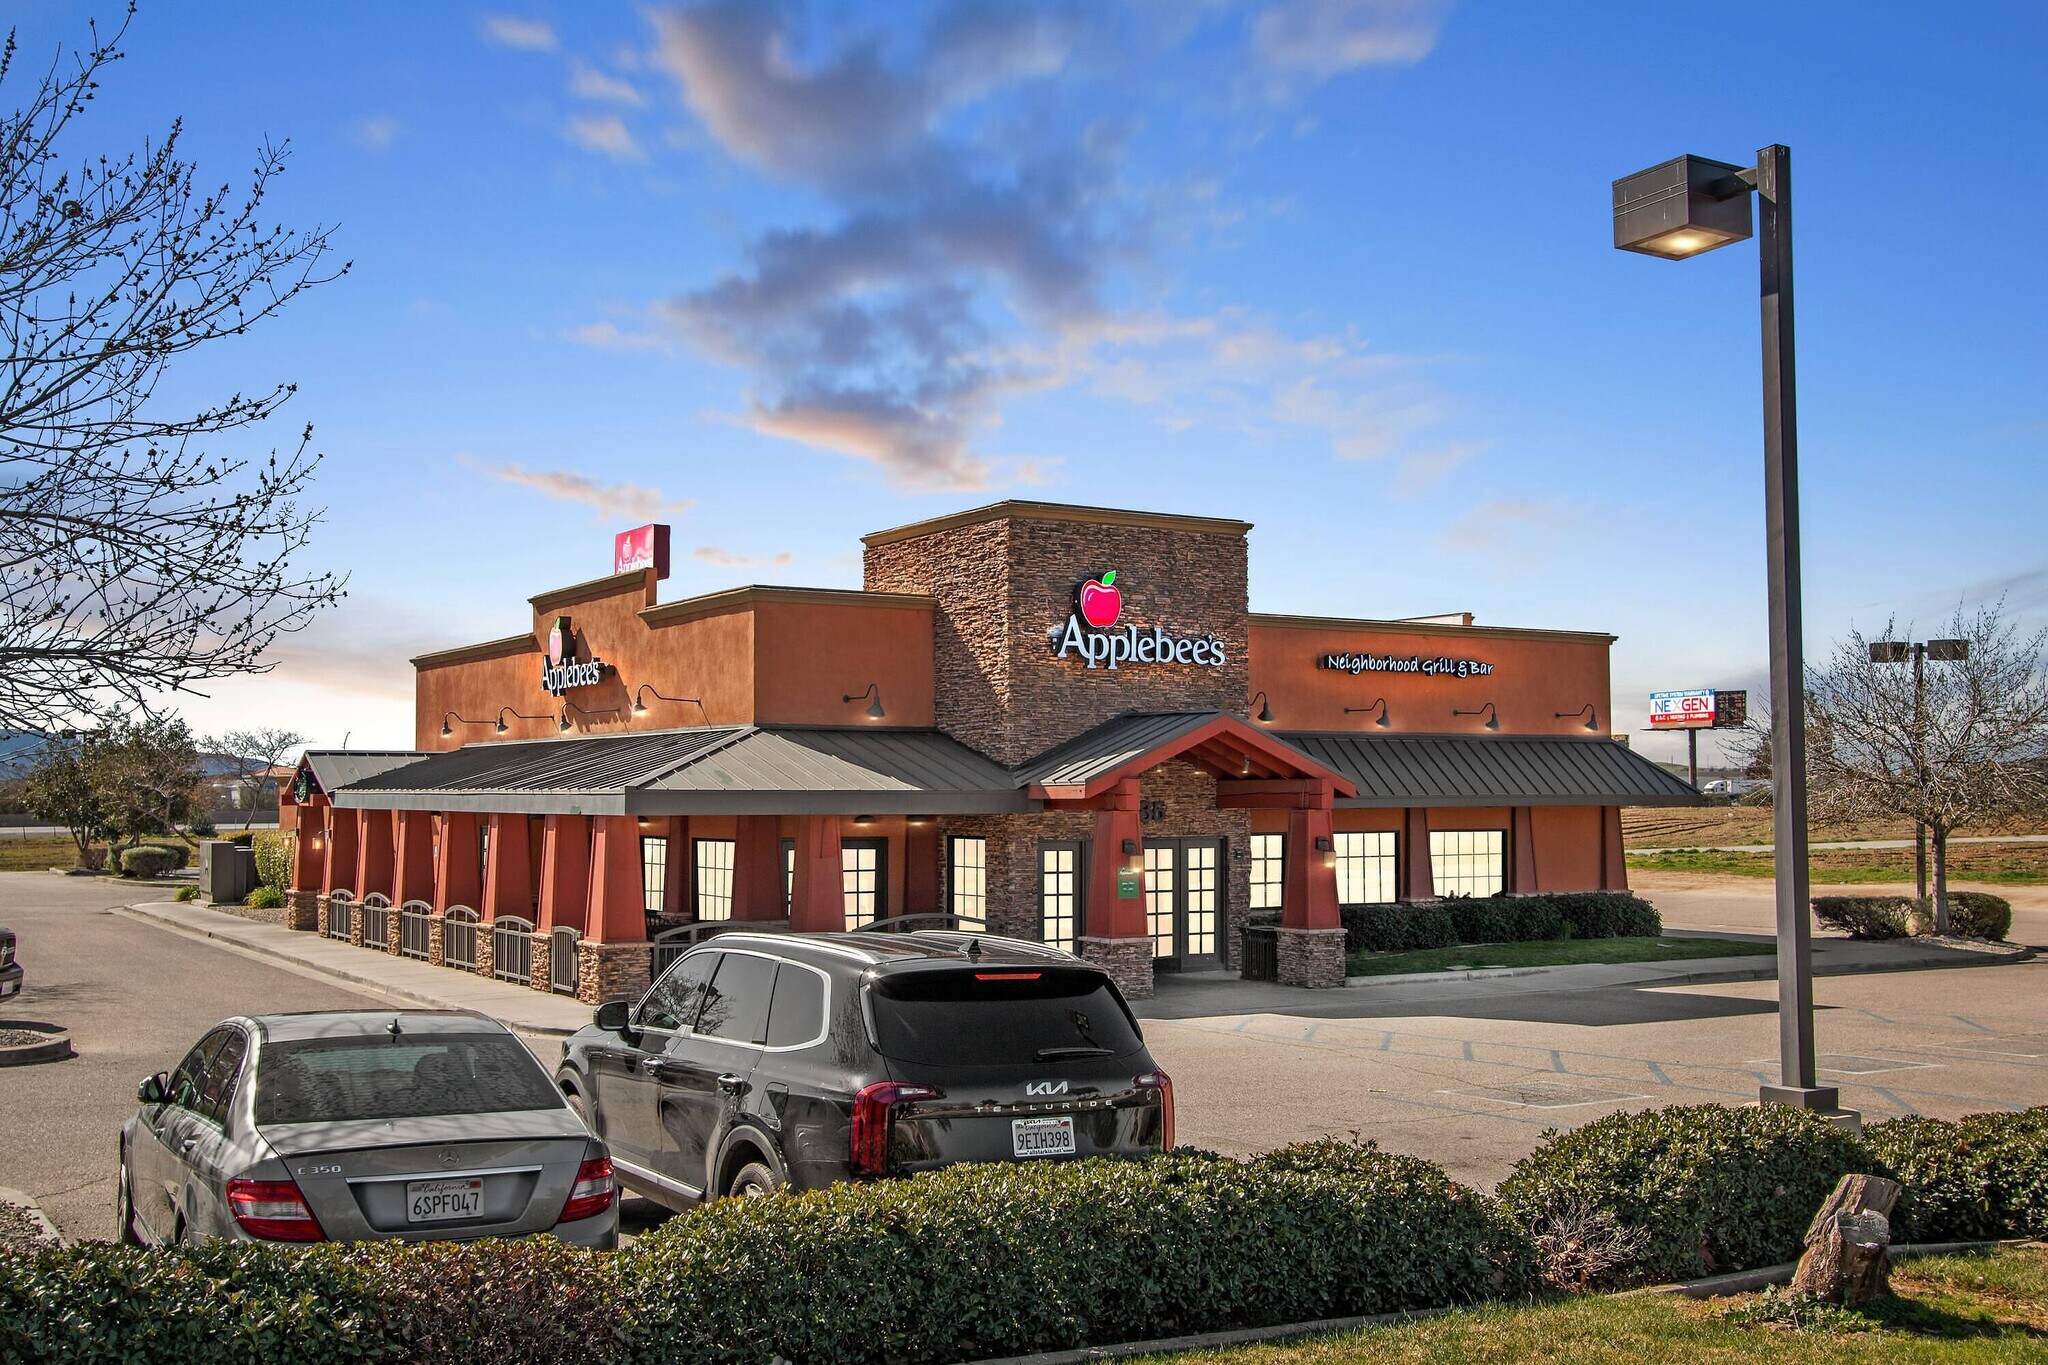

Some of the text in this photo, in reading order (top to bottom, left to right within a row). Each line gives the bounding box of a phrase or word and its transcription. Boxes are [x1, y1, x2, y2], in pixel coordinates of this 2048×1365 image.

[1057, 613, 1226, 670] Applebee's
[1328, 654, 1494, 678] Neighborhood Grill & Bar
[541, 655, 600, 697] Applebee's
[1026, 1081, 1068, 1096] KIA
[974, 1100, 1113, 1113] TELLURIDE
[1017, 1131, 1070, 1150] 9EIH398
[310, 1165, 342, 1174] 350
[423, 1182, 466, 1195] California
[413, 1192, 479, 1216] 6SPF047
